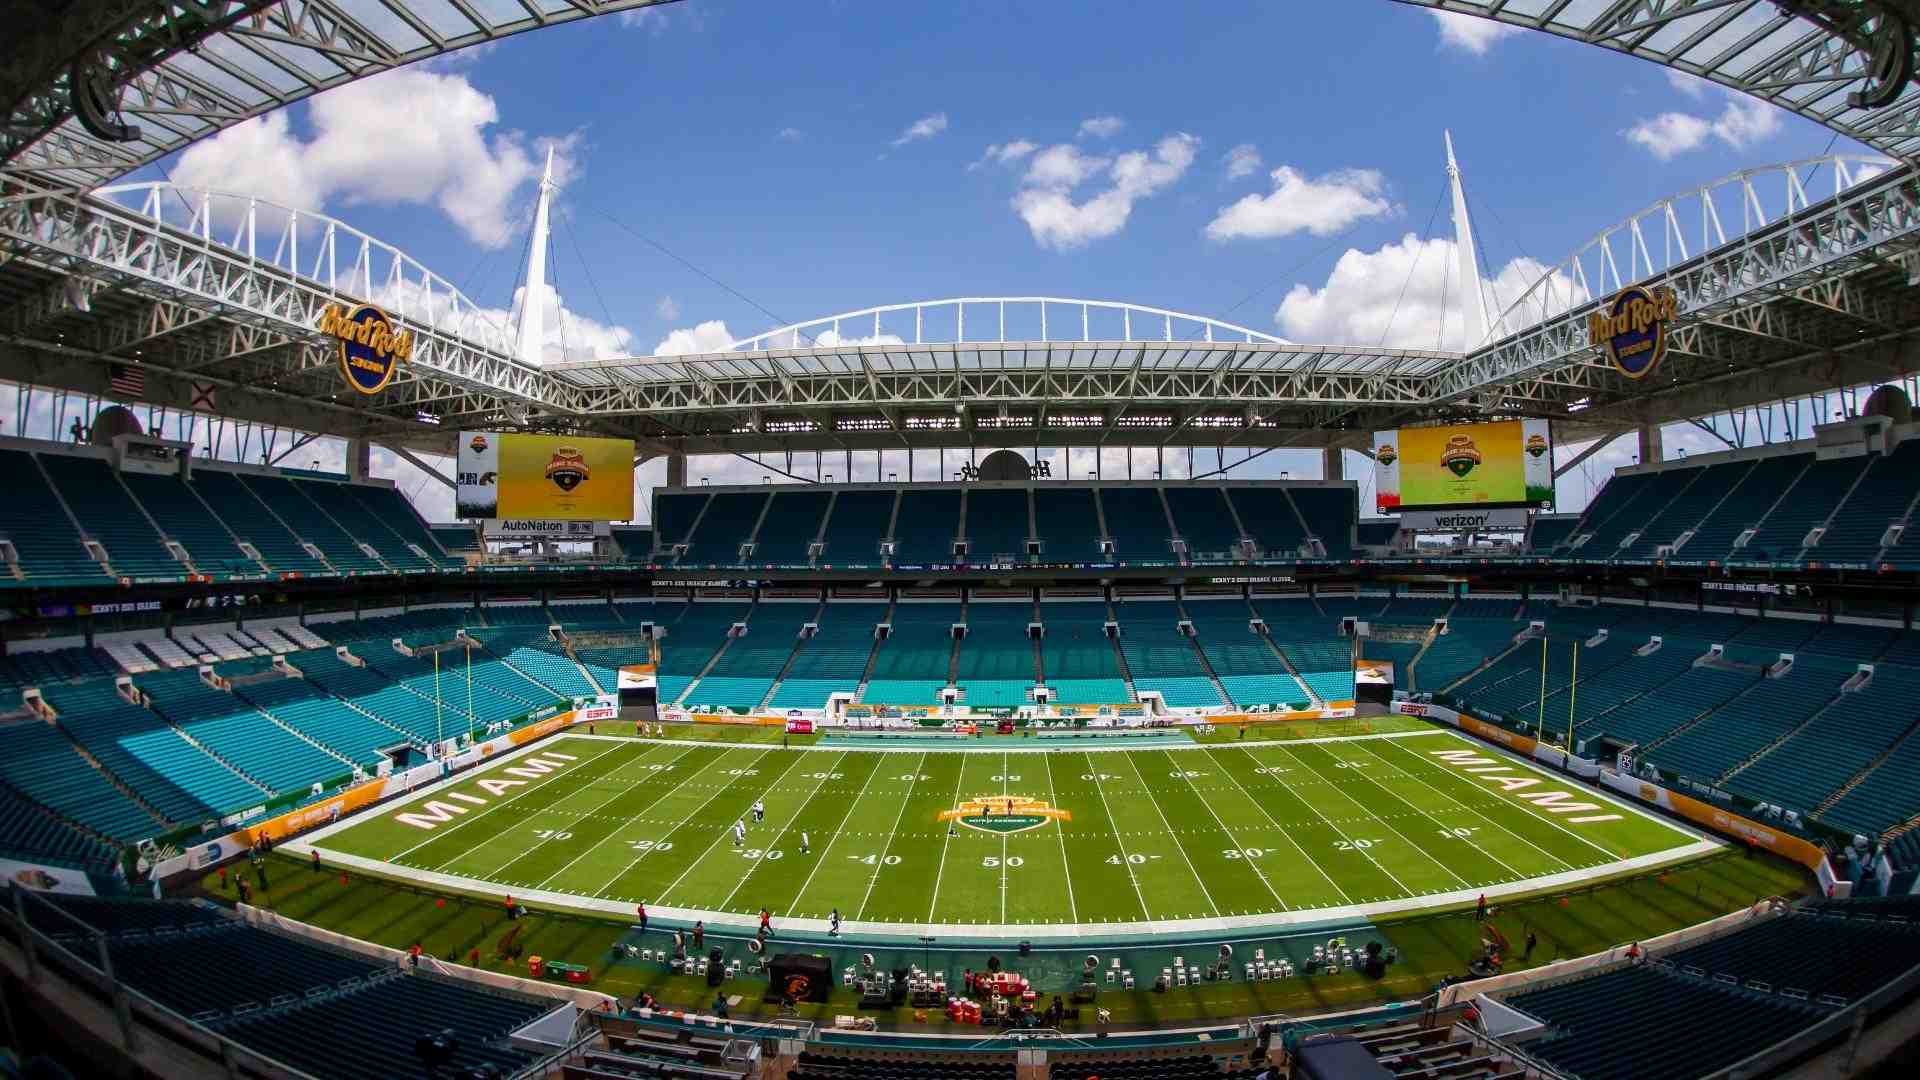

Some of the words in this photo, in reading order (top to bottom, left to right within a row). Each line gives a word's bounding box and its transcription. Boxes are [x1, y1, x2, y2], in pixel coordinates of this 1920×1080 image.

[1588, 301, 1630, 345] Hard
[1630, 287, 1677, 335] Rock
[320, 303, 373, 346] Hard
[368, 320, 414, 364] Rock
[502, 520, 562, 532] AutoNation
[1436, 516, 1484, 528] verizon
[586, 708, 613, 719] ESPN
[1400, 704, 1429, 716] ESPN
[394, 751, 579, 830] MIAMI
[1429, 750, 1625, 824] MIAMI
[1437, 827, 1472, 839] 10
[632, 840, 673, 851] 20
[1333, 839, 1372, 850] 20
[742, 849, 784, 860] 30
[1221, 848, 1264, 859] 30
[859, 854, 902, 865] 40
[982, 856, 1024, 867] 50
[1104, 854, 1146, 865] 40
